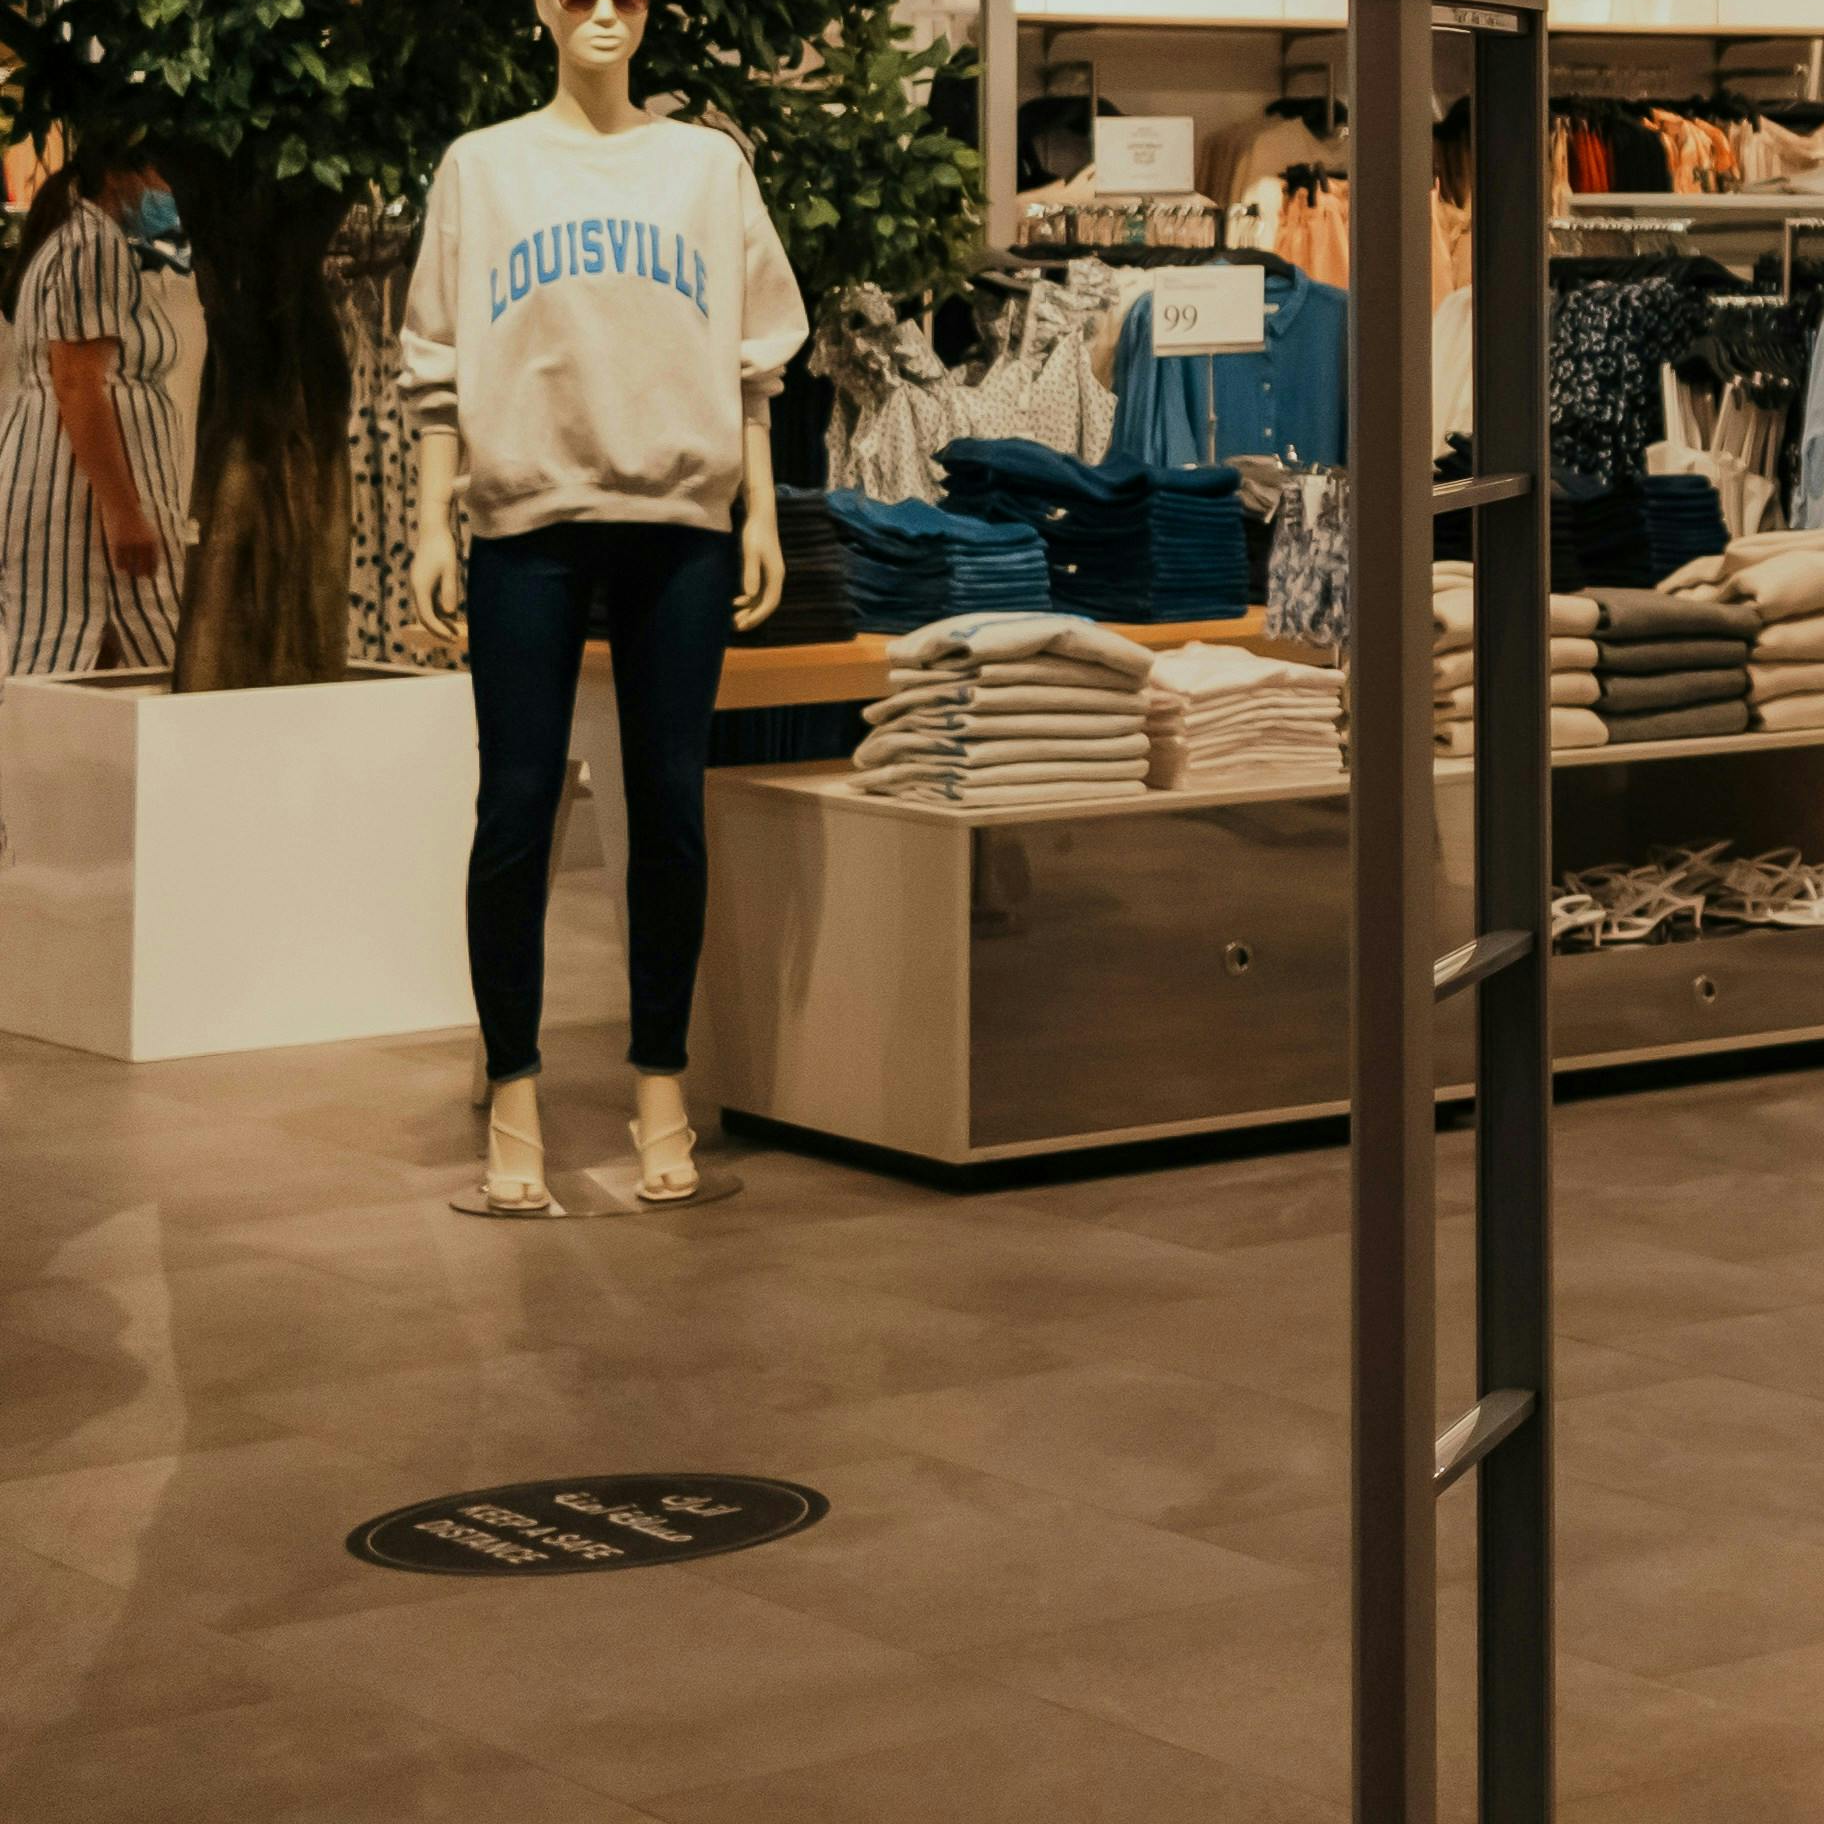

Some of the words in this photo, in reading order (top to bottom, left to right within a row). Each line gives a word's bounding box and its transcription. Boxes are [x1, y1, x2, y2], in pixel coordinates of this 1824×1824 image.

[490, 218, 710, 324] LOUISVILLE
[1163, 304, 1198, 333] 99
[413, 1518, 550, 1565] DISTANCE
[457, 1503, 538, 1528] KEEP
[541, 1533, 625, 1561] SAFE
